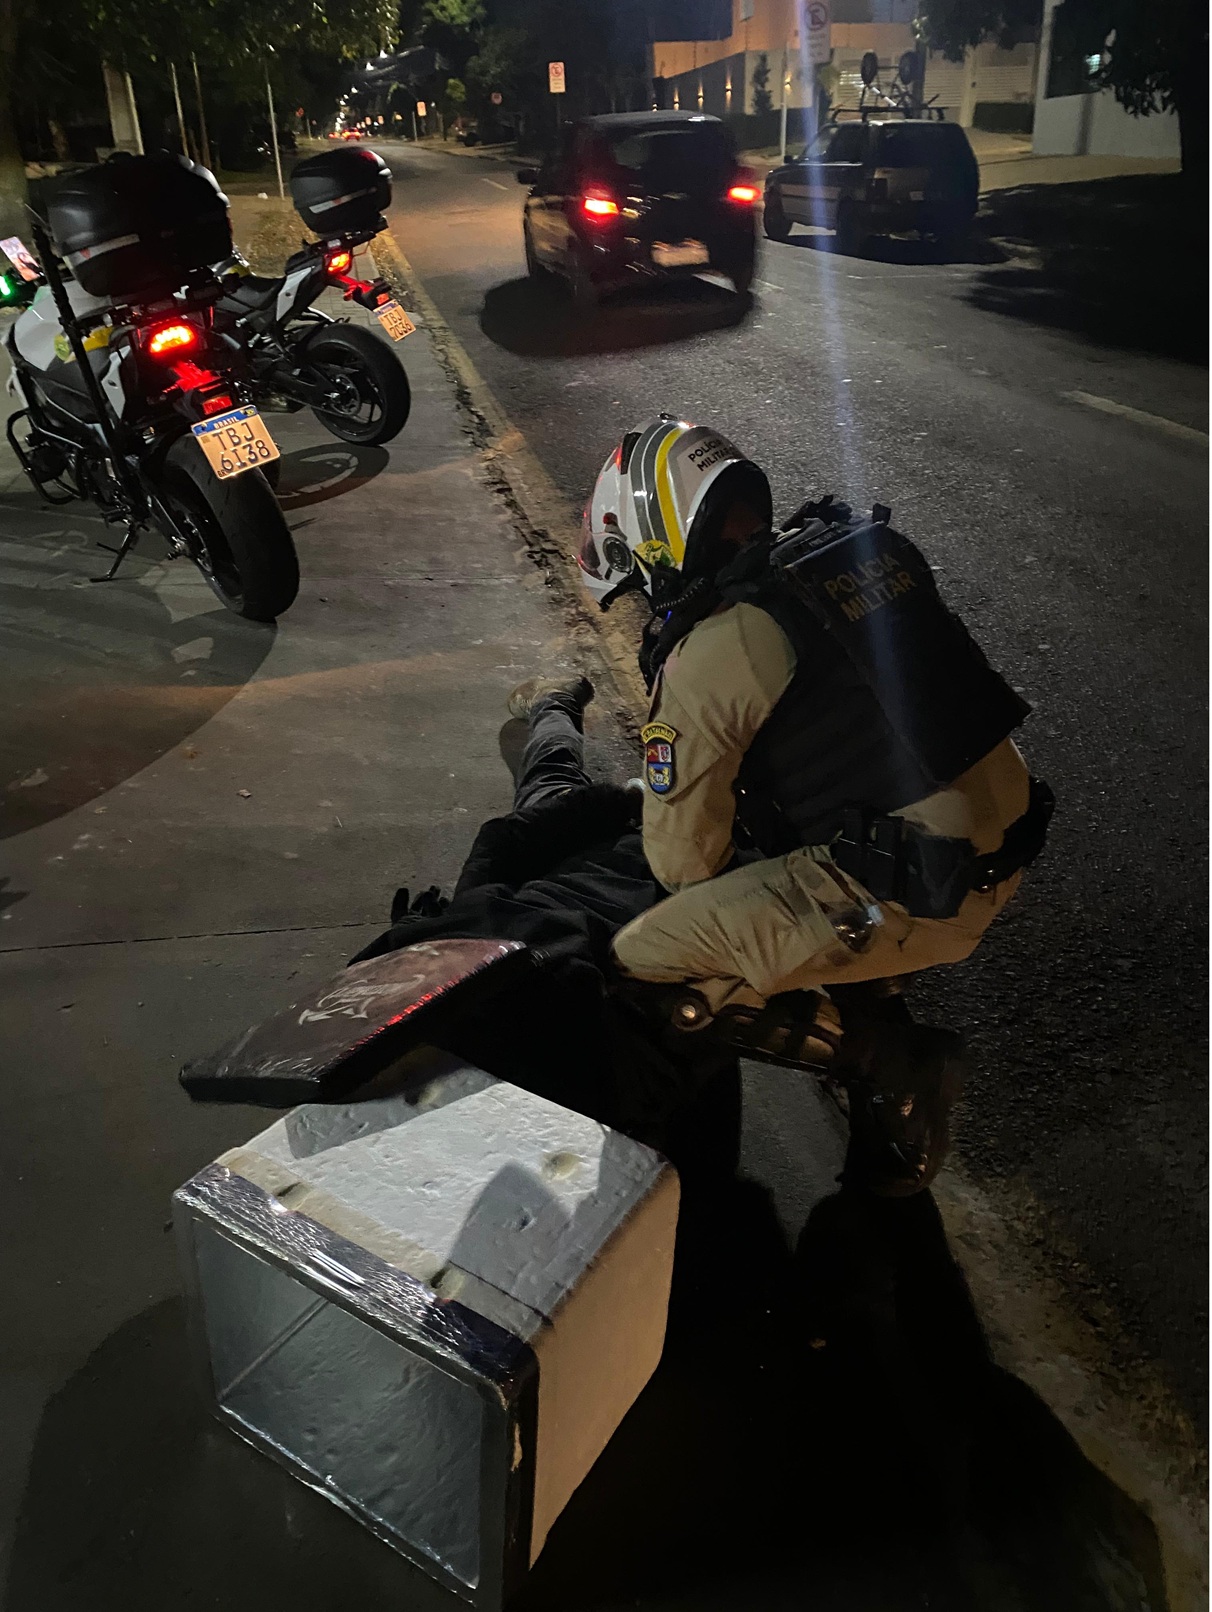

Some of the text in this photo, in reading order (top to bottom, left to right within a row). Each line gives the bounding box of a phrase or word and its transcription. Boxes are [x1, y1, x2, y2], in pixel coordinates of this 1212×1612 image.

[383, 309, 402, 326] TBJ
[213, 416, 240, 429] BRASIL
[212, 422, 254, 451] TBJ
[840, 570, 918, 622] MILITAR
